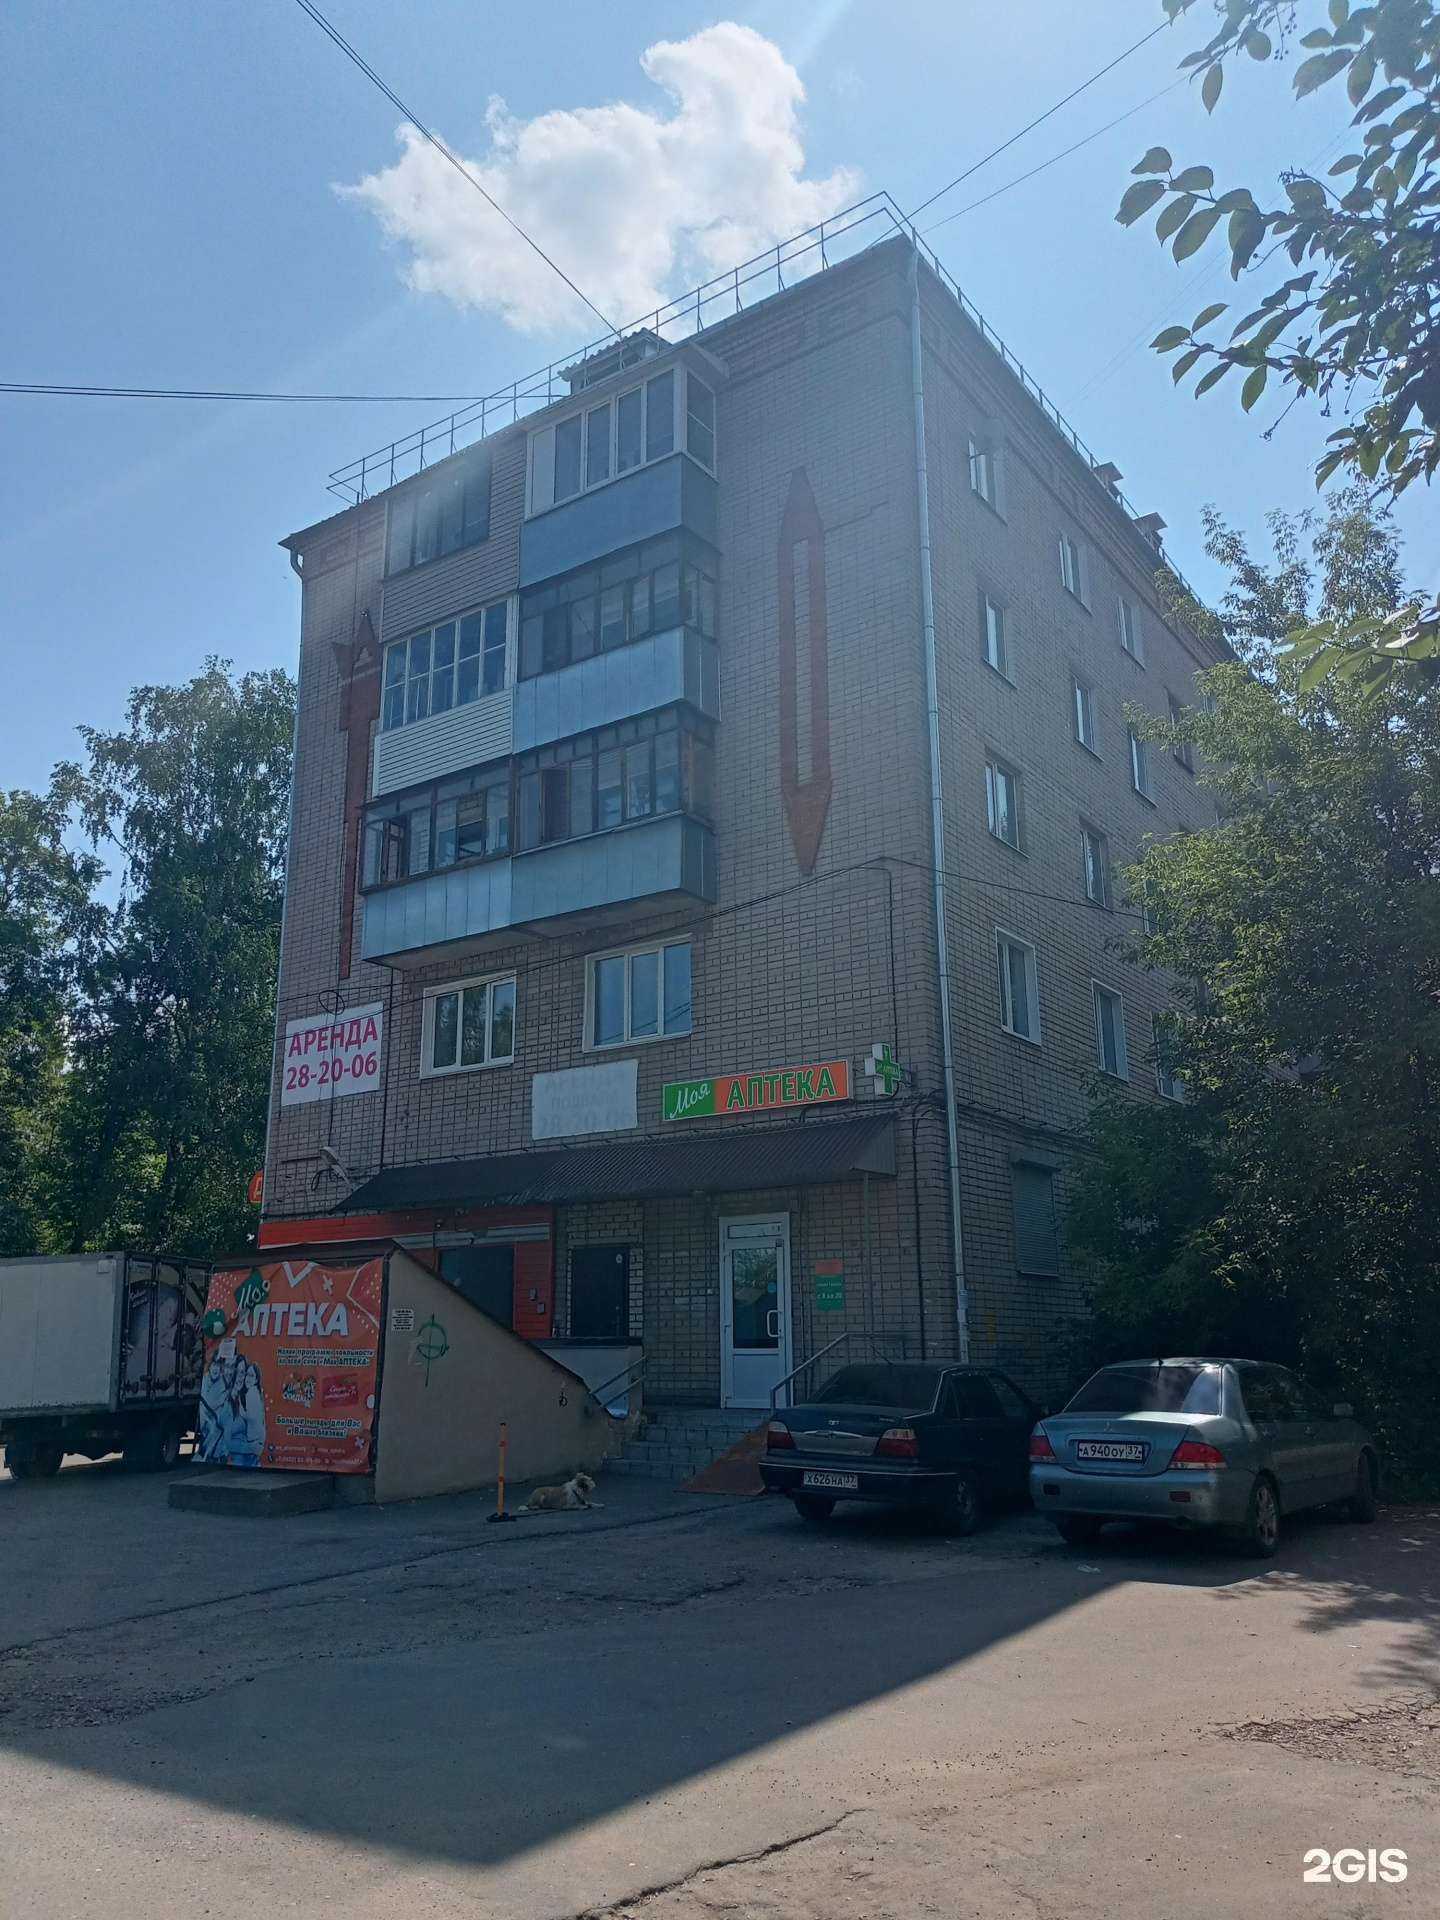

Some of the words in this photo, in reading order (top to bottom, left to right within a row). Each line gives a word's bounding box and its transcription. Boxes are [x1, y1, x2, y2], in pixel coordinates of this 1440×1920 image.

[287, 1016, 379, 1057] АРЕНДА
[286, 1051, 378, 1090] 28-20-06
[669, 1082, 711, 1119] Моя
[727, 1066, 838, 1111] АПТЕКА
[231, 1302, 349, 1337] АПТЕКА
